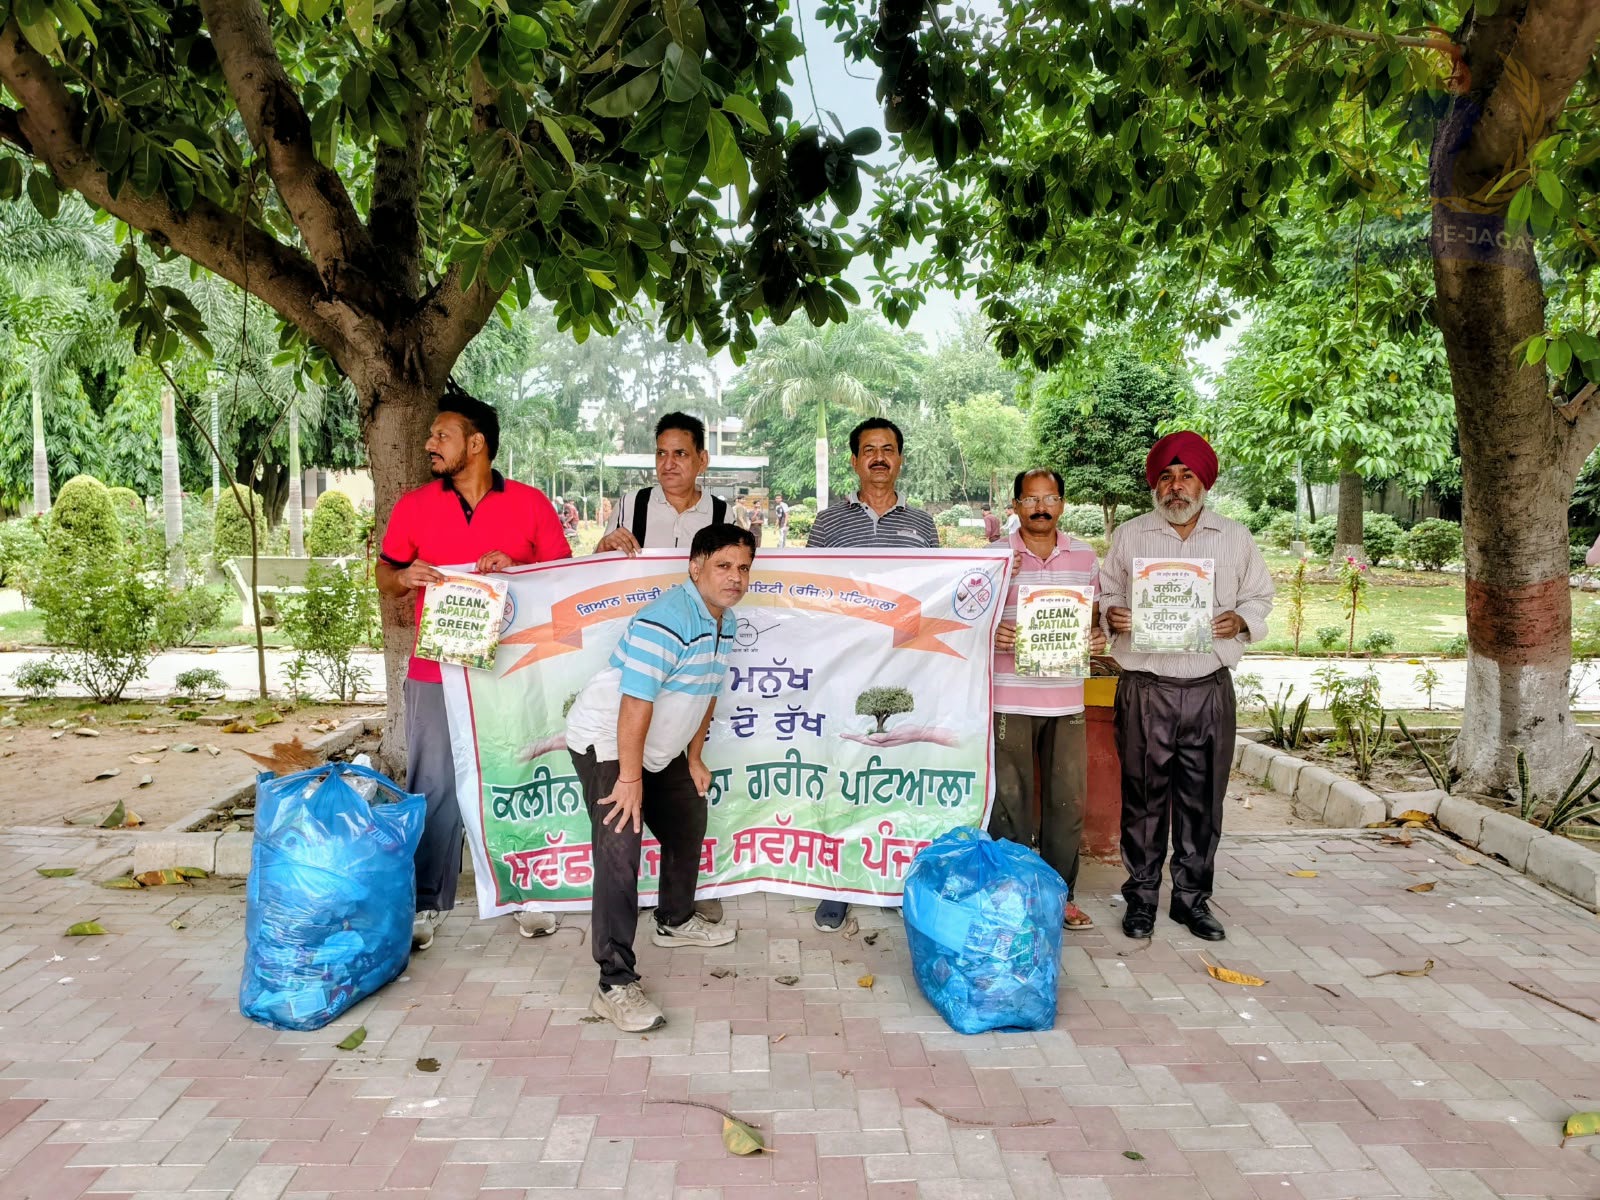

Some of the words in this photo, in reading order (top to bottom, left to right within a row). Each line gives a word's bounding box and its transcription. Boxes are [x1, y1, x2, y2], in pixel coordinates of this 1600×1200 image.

[1153, 581, 1181, 592] ਕਲੀਨ
[446, 594, 482, 609] CLEAN
[577, 596, 620, 615] ਗਿਆਨ
[840, 591, 896, 611] ਪਟਿਆਲਾ
[1152, 593, 1192, 603] ਪਟਿਆਲਾ
[447, 607, 490, 619] PATIALA
[1036, 608, 1070, 619] CLEAN
[437, 618, 479, 631] GREEN
[1039, 618, 1080, 630] PATIALA
[1145, 619, 1187, 631] ਪਟਿਆਲਾ
[435, 628, 483, 640] PATIALA
[1031, 632, 1071, 642] GREEN
[1031, 642, 1077, 651] PATIALA
[729, 657, 813, 698] ਮਨੁੱਖ
[774, 704, 826, 741] ਰੁੱਖ
[491, 766, 580, 822] ਕਲੀਨ
[745, 748, 828, 801] ਗਰੀਨ
[839, 755, 976, 807] ਪਟਿਆਲਾ
[733, 814, 844, 873] ਸਵੱਸਥ
[861, 820, 932, 877] ਪੰਜ
